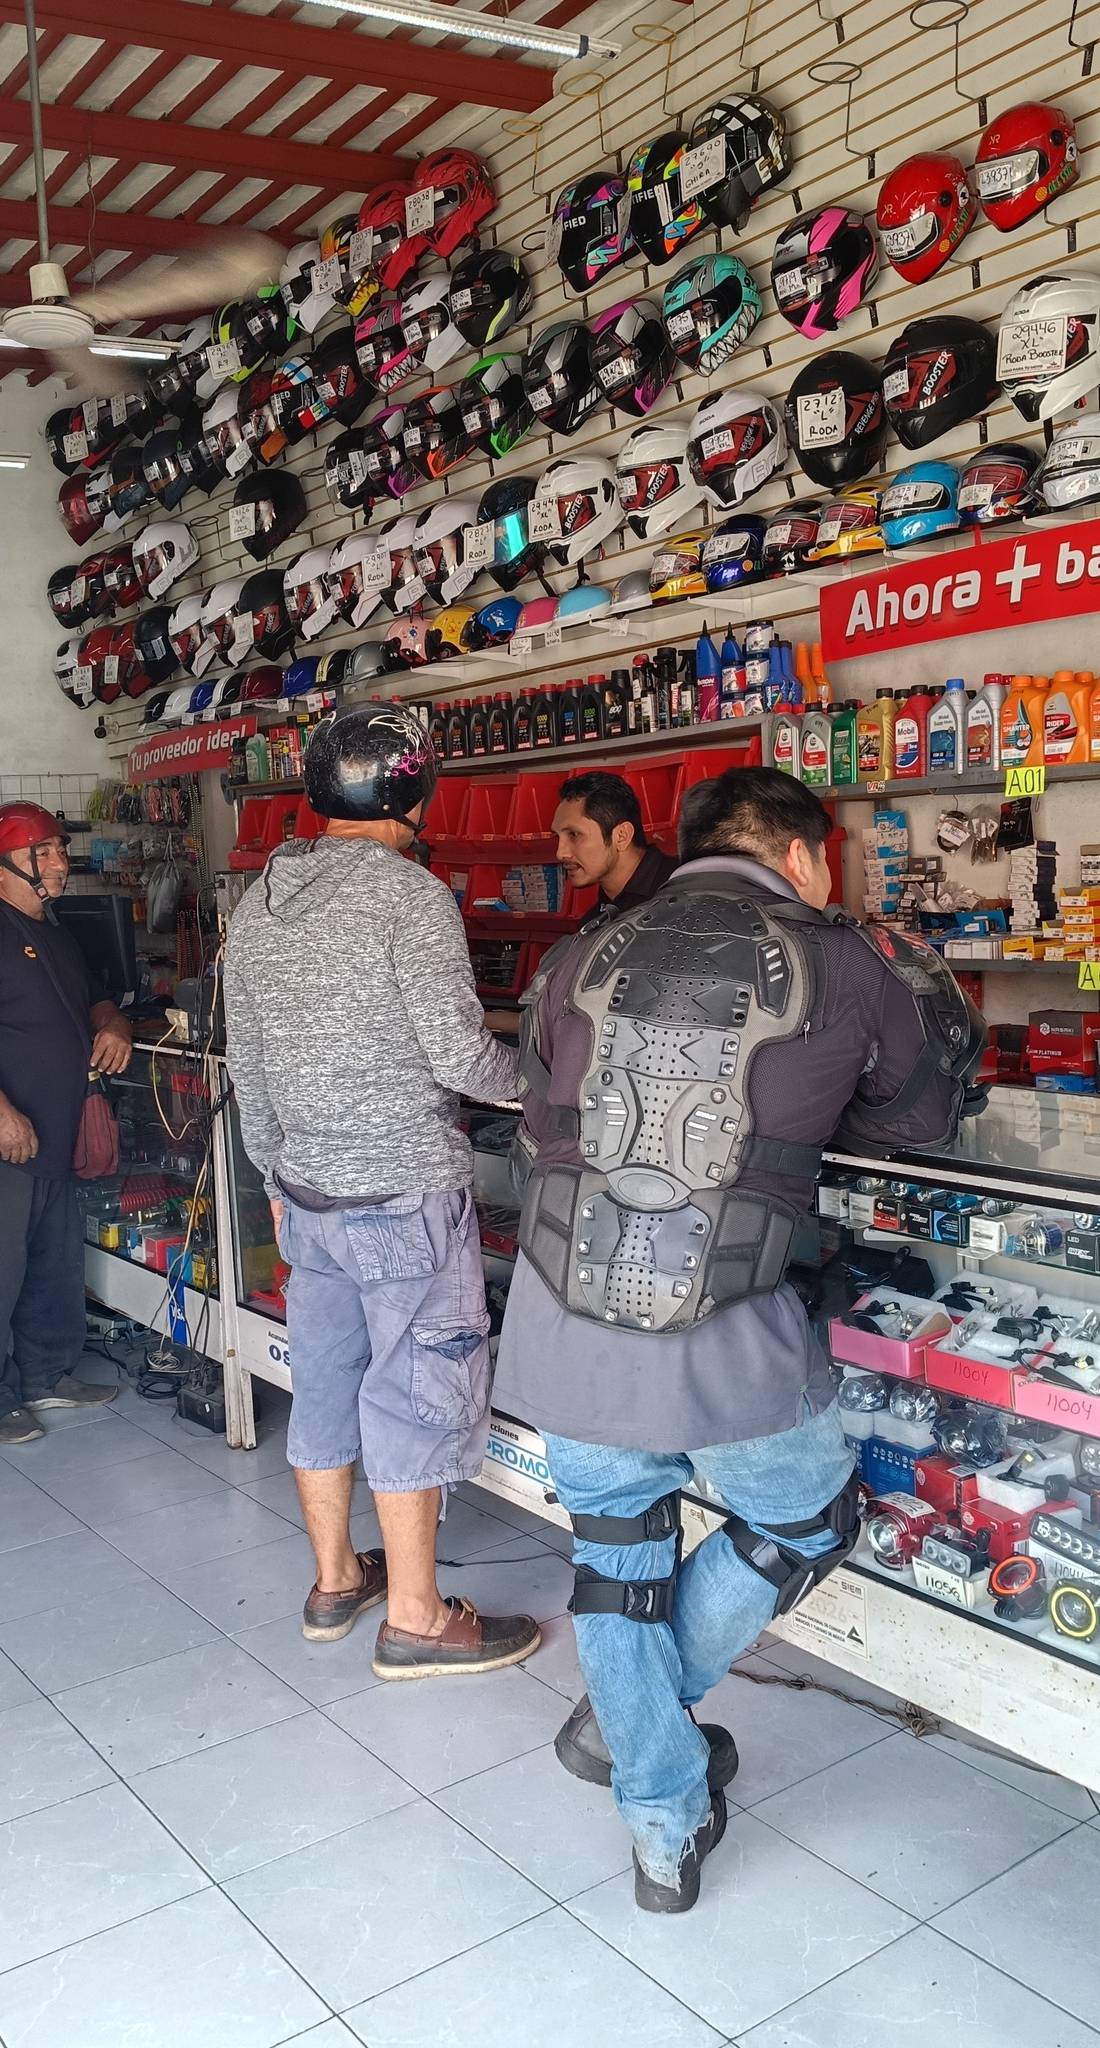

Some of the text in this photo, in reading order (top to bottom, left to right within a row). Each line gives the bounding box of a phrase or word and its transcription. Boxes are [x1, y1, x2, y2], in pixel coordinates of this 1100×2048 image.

[684, 140, 721, 166] 27690
[632, 188, 656, 205] IFIE
[563, 215, 586, 231] FIED
[1012, 322, 1056, 340] 29446
[1002, 349, 1064, 364] RODA BOOSTER
[922, 350, 952, 396] BOOSTER
[809, 424, 838, 438] RODA
[646, 463, 671, 501] BOOSTER
[531, 497, 558, 513] 2944
[564, 493, 586, 530] BOOSTER
[533, 523, 553, 534] RODA
[468, 549, 486, 560] RODA
[367, 573, 384, 582] RODA
[845, 570, 982, 637] Ahora
[897, 727, 915, 736] Mobil
[1003, 724, 1030, 732] SMARTER
[1046, 719, 1064, 727] RIDER
[131, 752, 142, 772] Tu
[143, 736, 203, 771] proveedor
[1008, 768, 1041, 795] A01
[1080, 963, 1096, 989] A
[953, 1360, 989, 1385] 11004
[1047, 1393, 1092, 1420] 11004
[490, 1423, 519, 1442] cciones
[840, 1581, 862, 1596] SIEM
